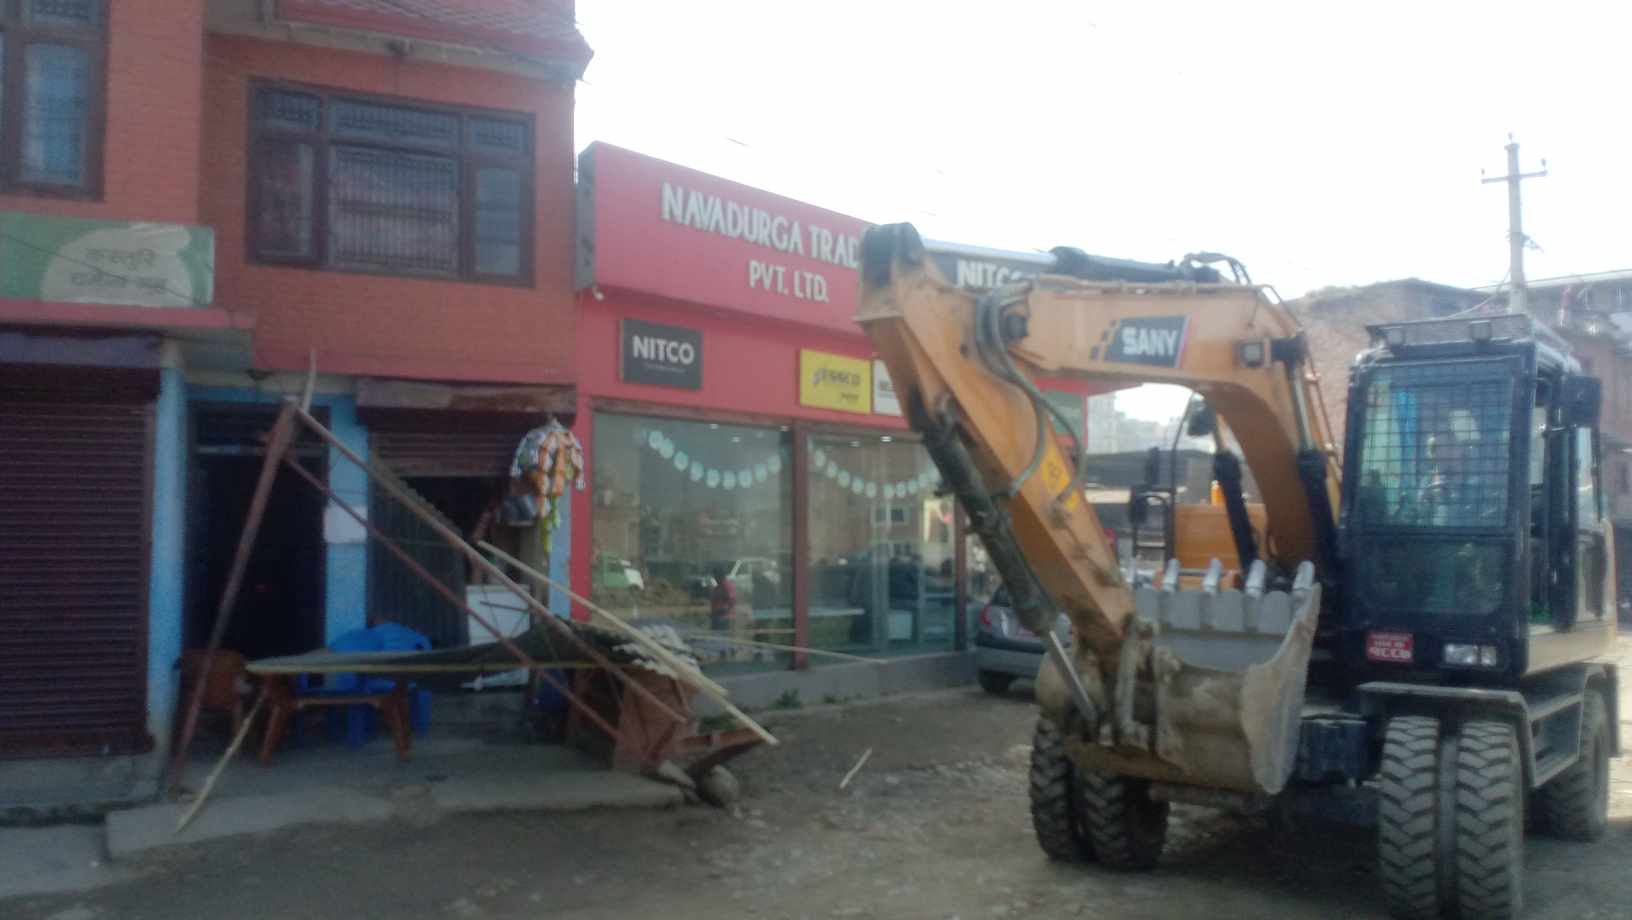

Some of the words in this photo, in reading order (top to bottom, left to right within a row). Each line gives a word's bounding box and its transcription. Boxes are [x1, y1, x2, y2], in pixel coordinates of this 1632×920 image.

[661, 181, 804, 256] NAVADURGA
[749, 260, 788, 295] PVT.
[793, 270, 829, 303] LTD.
[632, 335, 695, 365] NITCO
[1122, 326, 1178, 357] SANY
